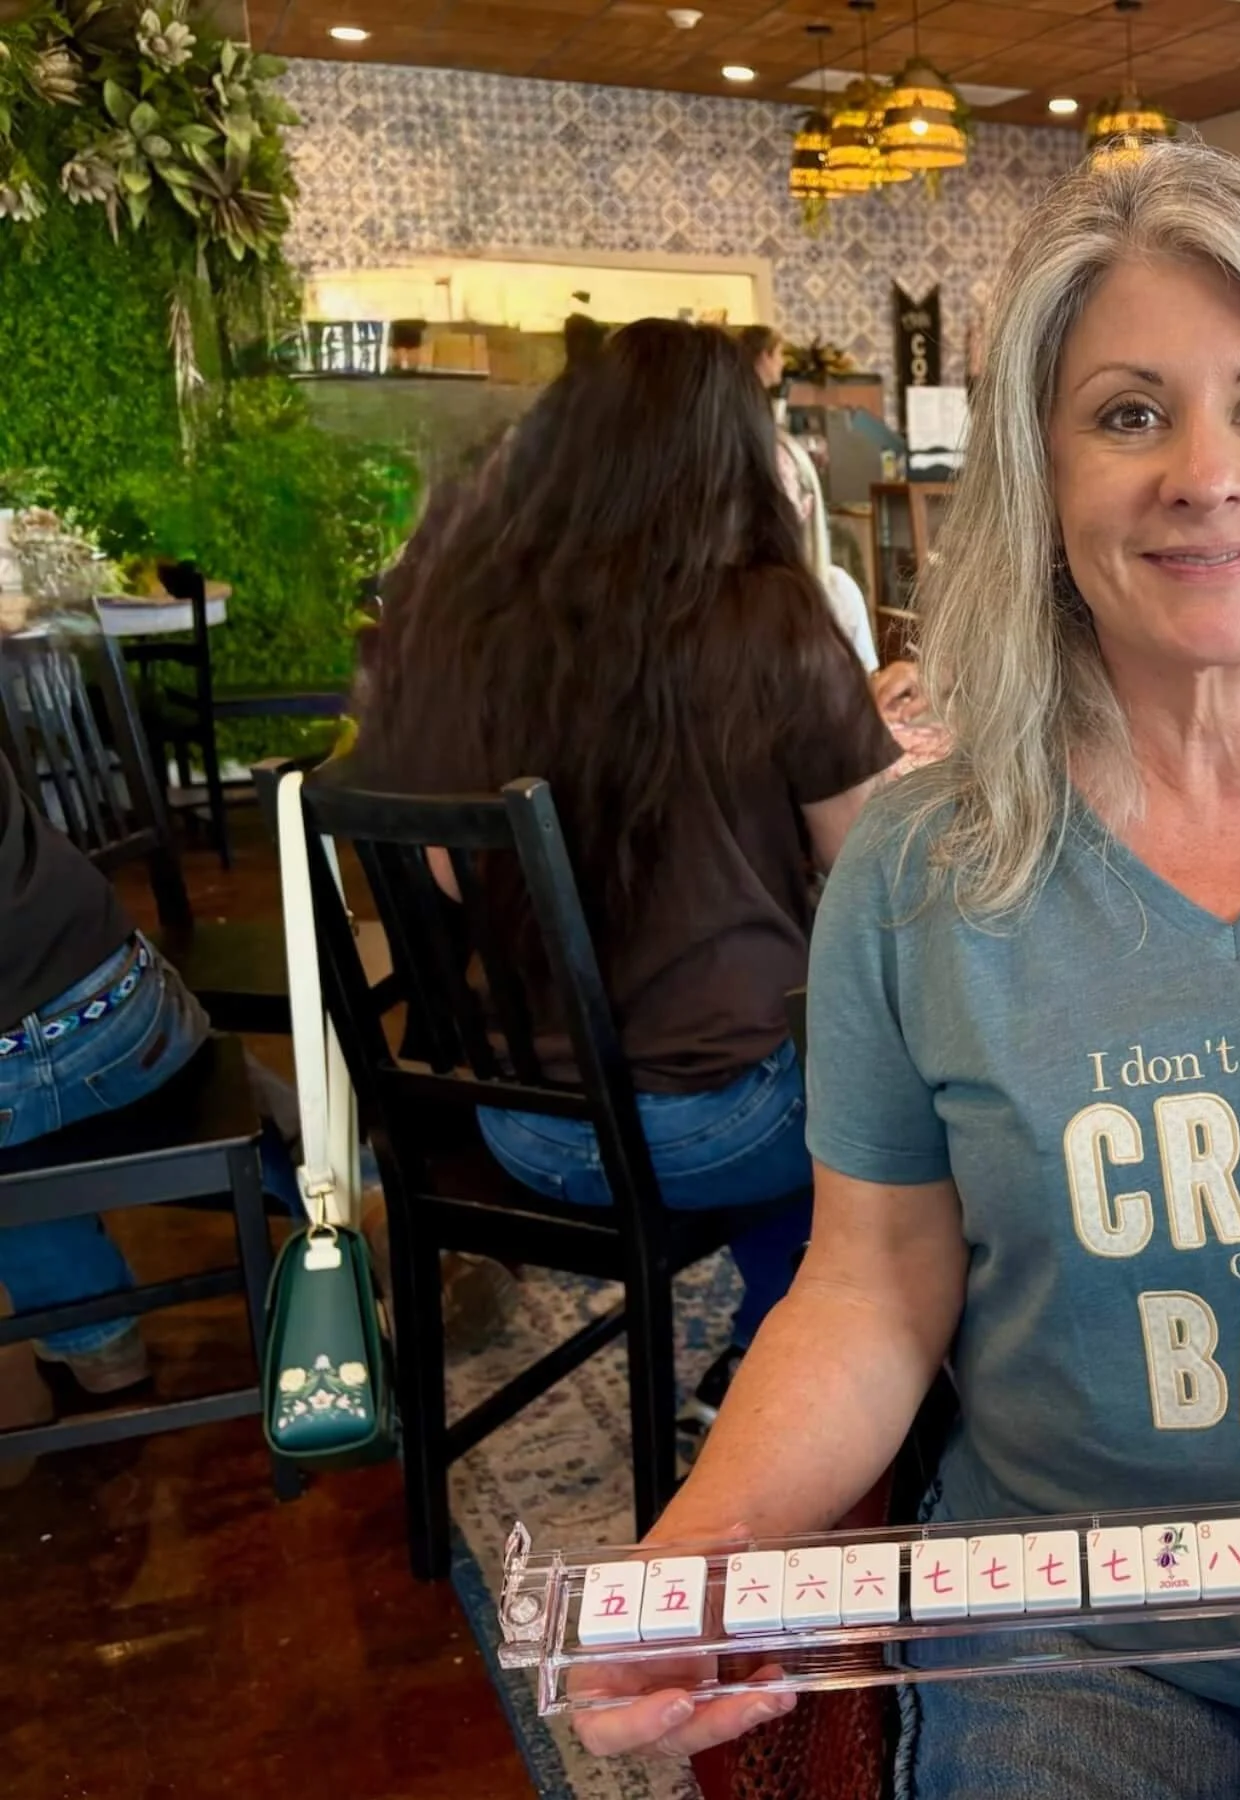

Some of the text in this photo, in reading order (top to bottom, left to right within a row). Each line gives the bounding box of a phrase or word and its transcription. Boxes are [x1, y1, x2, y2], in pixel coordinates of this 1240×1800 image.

[1087, 1051, 1113, 1093] I
[1121, 1036, 1239, 1088] don't
[1091, 1532, 1100, 1548] 7
[1200, 1524, 1211, 1539] 8
[915, 1543, 925, 1559] 7
[971, 1539, 981, 1555] 7
[1027, 1536, 1037, 1551] 7
[730, 1556, 743, 1572] 6
[788, 1552, 800, 1568] 6
[846, 1549, 857, 1564] 6
[589, 1566, 601, 1582] 5
[649, 1561, 662, 1578] 5
[980, 1557, 1010, 1590] 七
[1037, 1553, 1067, 1586] 七
[1101, 1549, 1131, 1582] 七
[853, 1569, 886, 1596] 六
[923, 1560, 953, 1594] 七
[1159, 1578, 1190, 1589] JOKER
[655, 1578, 690, 1612] 五
[737, 1577, 771, 1605] 六
[795, 1573, 828, 1600] 六
[593, 1584, 629, 1617] 五
